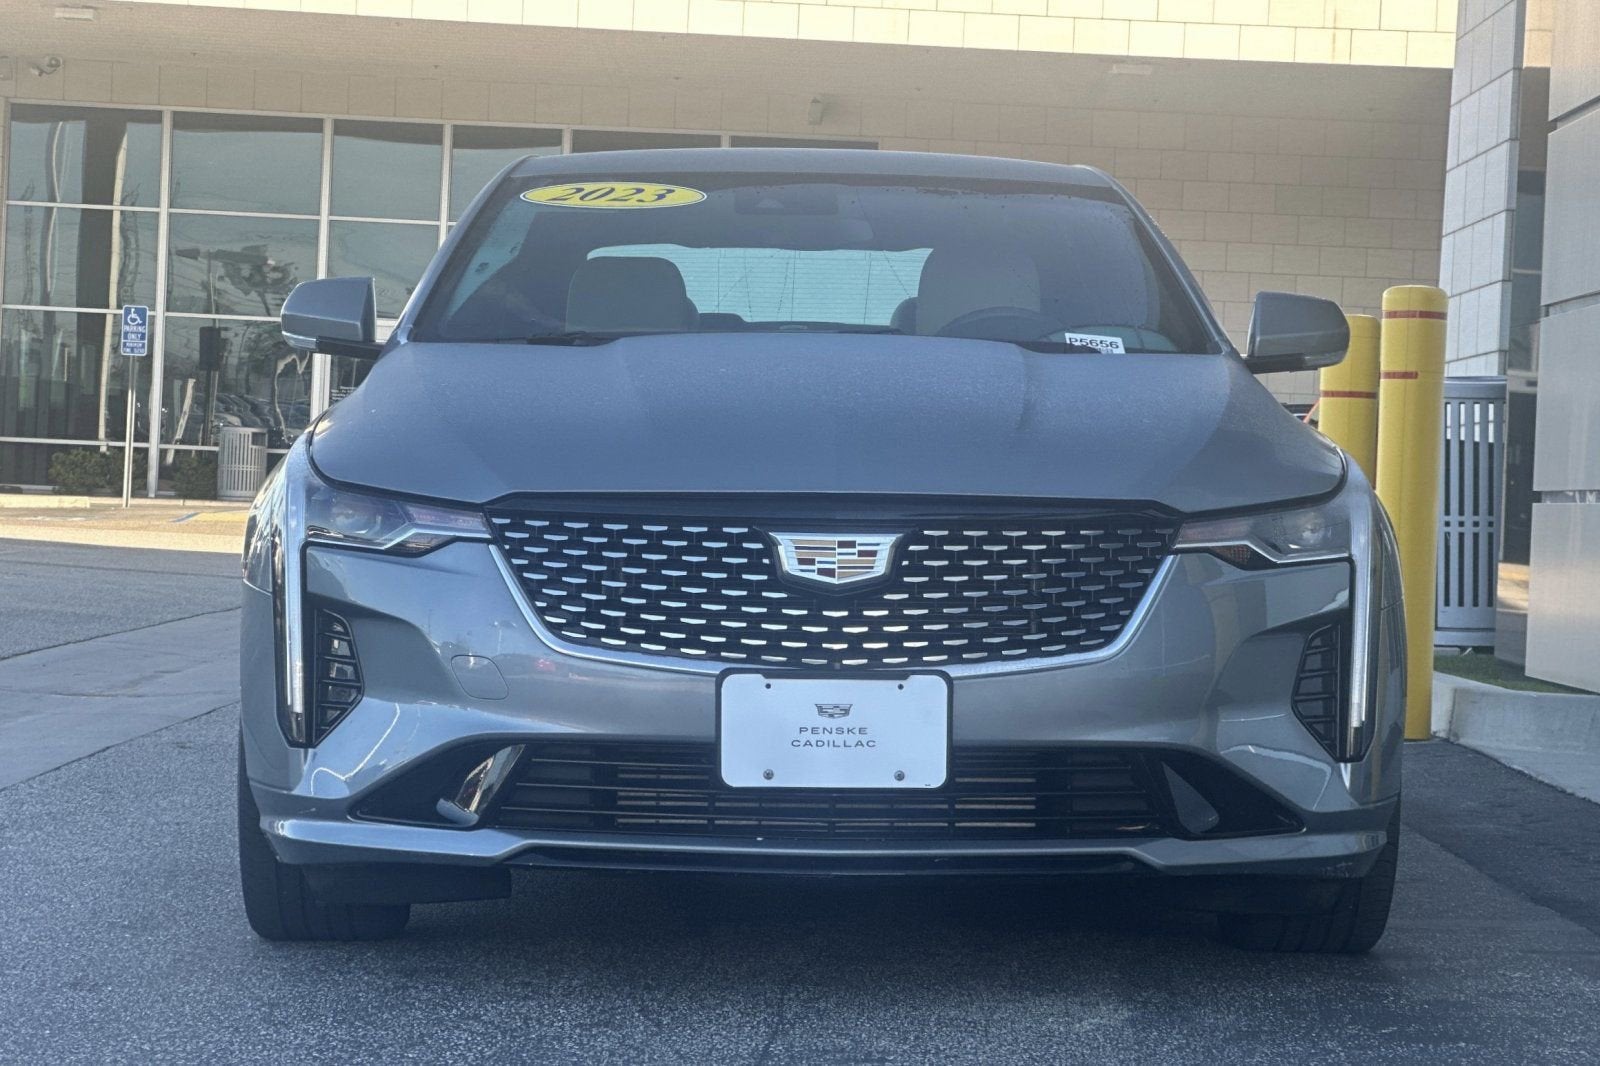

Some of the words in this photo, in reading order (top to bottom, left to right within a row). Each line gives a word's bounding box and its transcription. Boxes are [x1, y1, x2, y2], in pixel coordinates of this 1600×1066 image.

[545, 187, 675, 203] 2023
[123, 325, 146, 333] PARKING
[1068, 337, 1120, 350] P5656
[799, 727, 868, 735] PENSKE
[791, 740, 876, 748] CADILLAC
